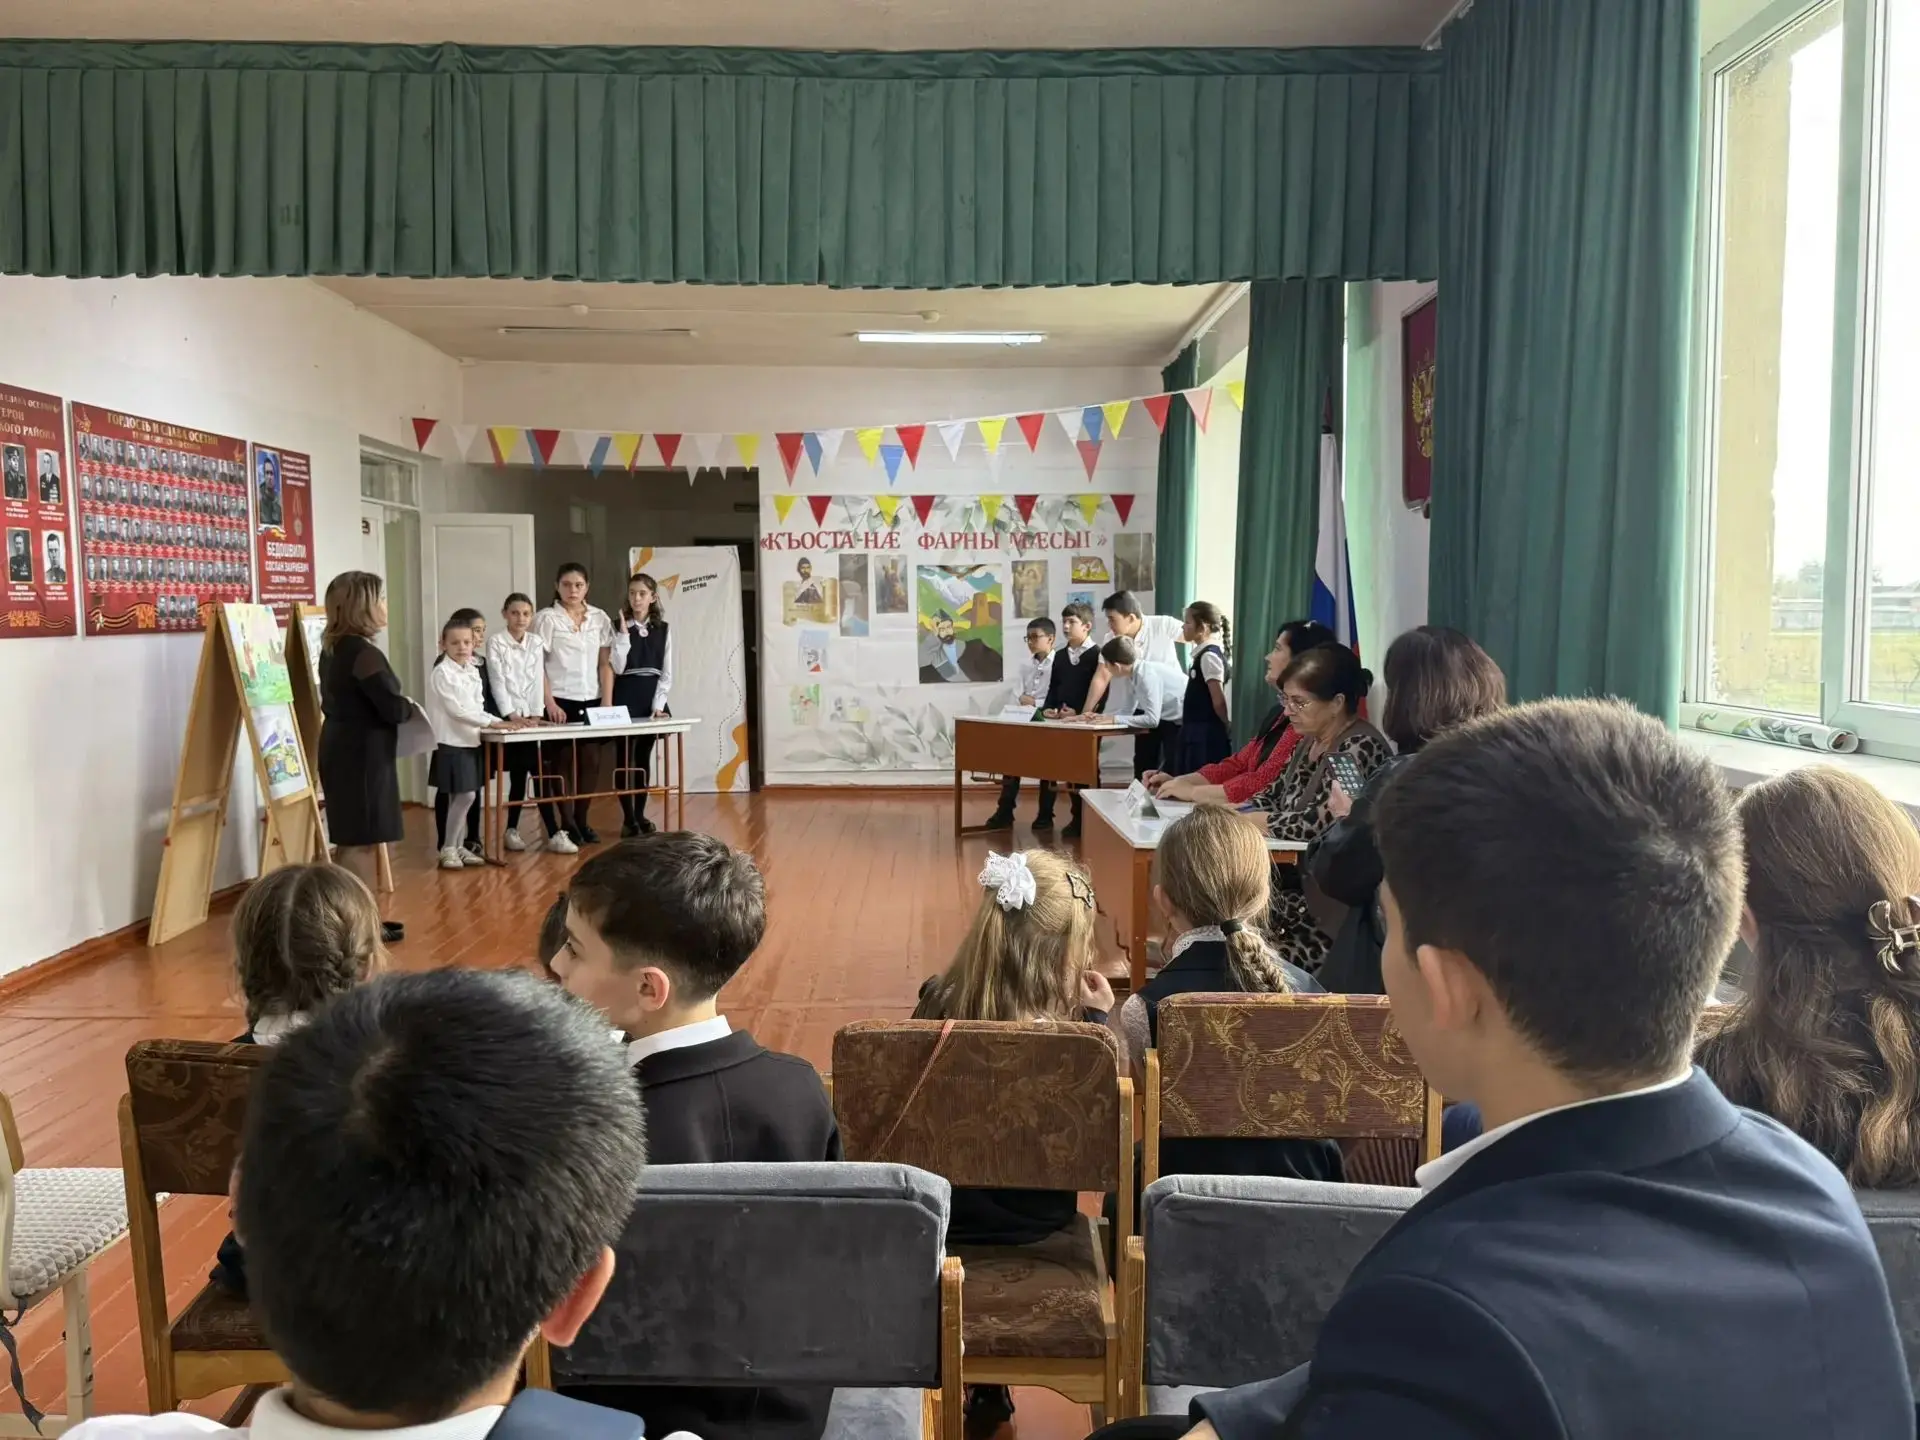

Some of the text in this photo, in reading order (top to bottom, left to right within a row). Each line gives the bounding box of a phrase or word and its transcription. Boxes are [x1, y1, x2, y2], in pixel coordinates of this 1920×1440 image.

[0, 406, 25, 421] ЕРОИ
[23, 426, 56, 440] РАЙОНА
[107, 412, 152, 433] ГОРДОСТЬ
[160, 425, 187, 440] СЛАВА
[917, 531, 1000, 550] ФАРНЫ
